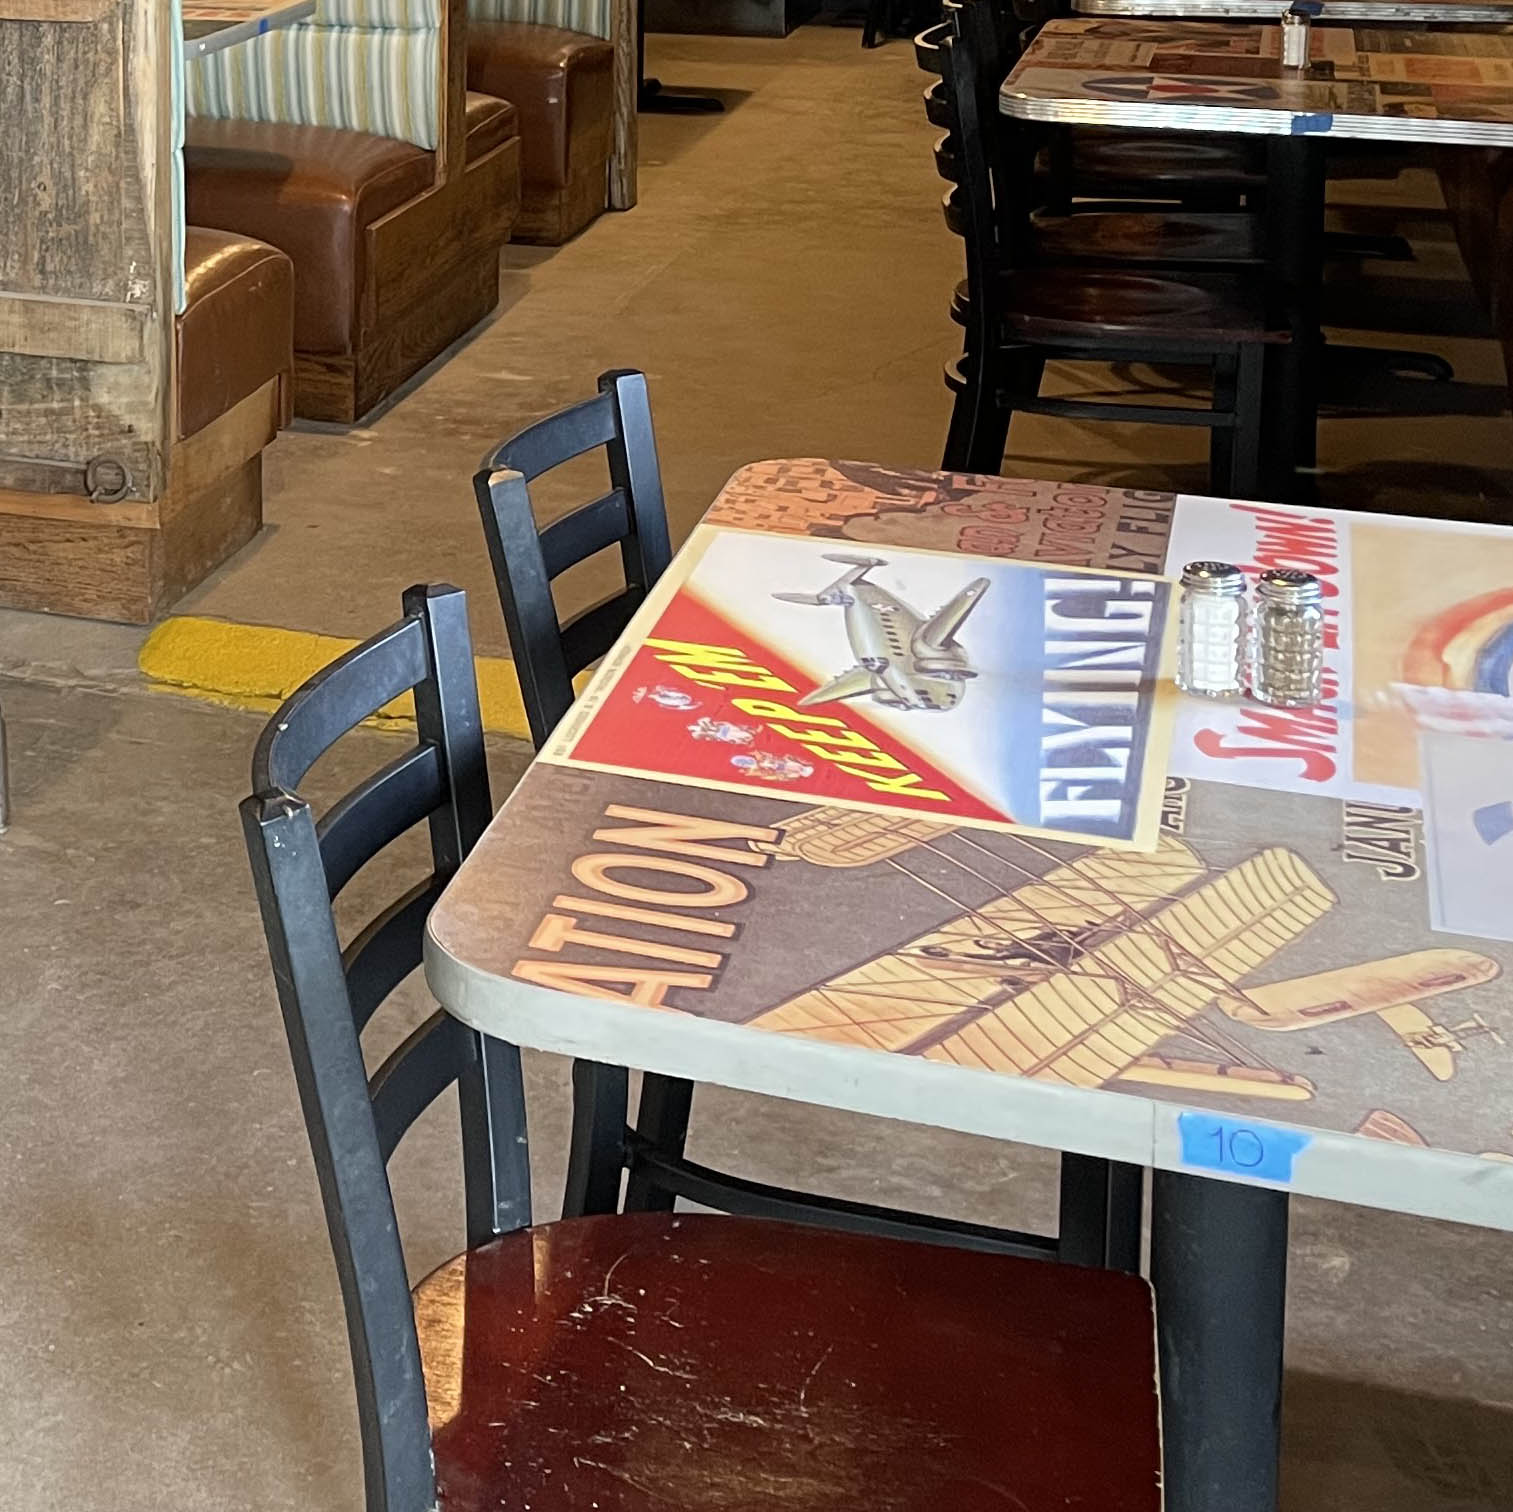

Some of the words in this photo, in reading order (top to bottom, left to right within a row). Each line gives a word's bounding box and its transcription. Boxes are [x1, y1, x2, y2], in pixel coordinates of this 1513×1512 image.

[732, 698, 952, 802] KEEP
[1040, 578, 1155, 824] FLYING!
[1209, 1125, 1264, 1168] 10
